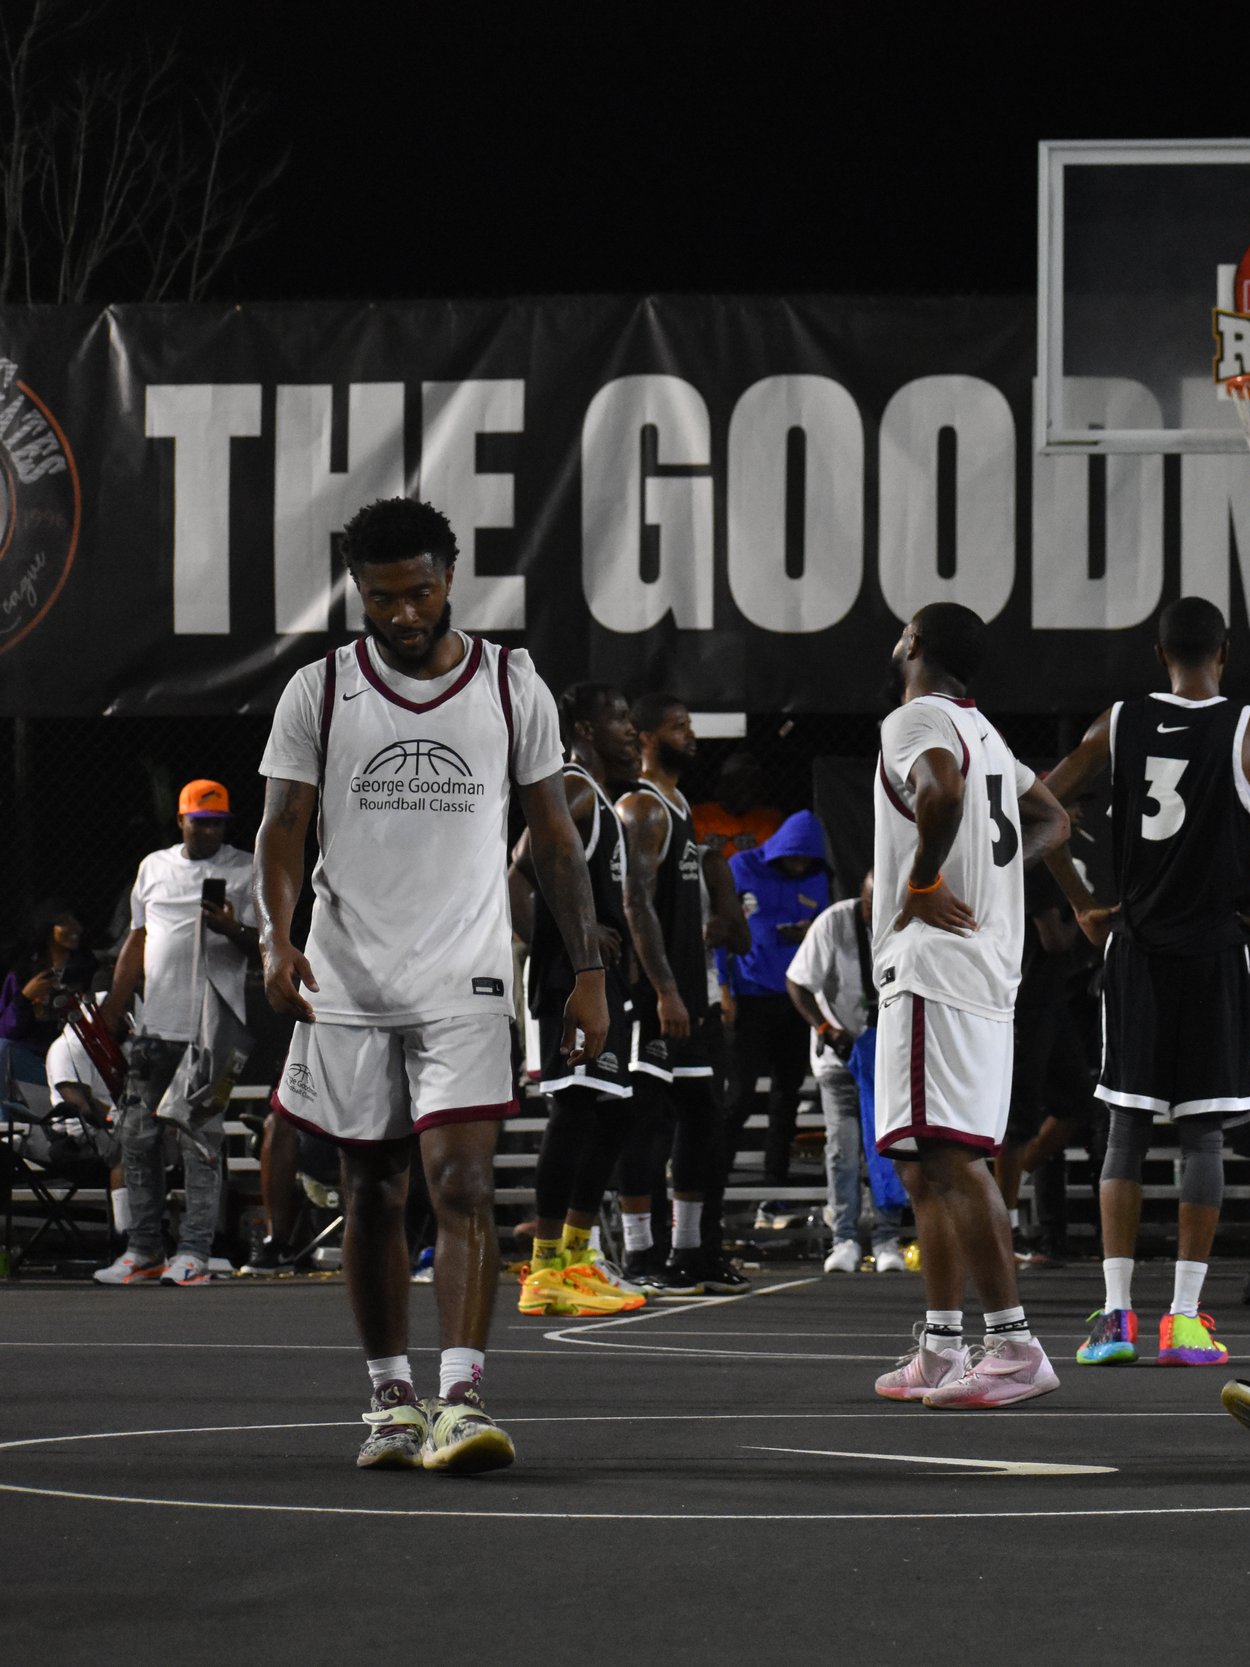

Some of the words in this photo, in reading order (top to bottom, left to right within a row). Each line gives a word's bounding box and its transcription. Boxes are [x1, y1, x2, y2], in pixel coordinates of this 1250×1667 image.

[145, 379, 527, 636] THE
[350, 776, 404, 797] George
[408, 777, 485, 796] Goodman
[359, 797, 426, 811] Roundball
[429, 798, 476, 813] Classic
[1140, 755, 1191, 842] 3
